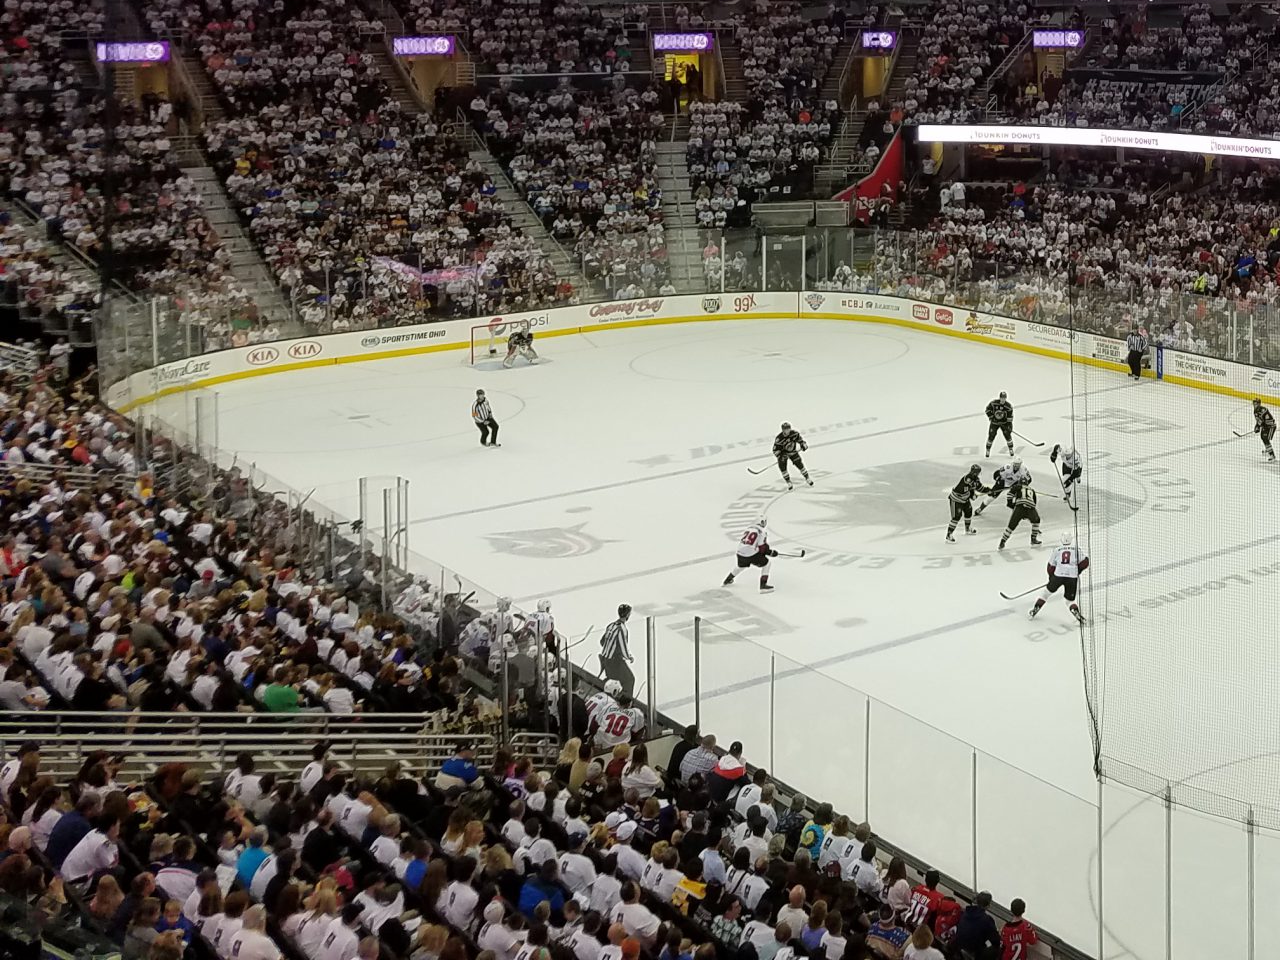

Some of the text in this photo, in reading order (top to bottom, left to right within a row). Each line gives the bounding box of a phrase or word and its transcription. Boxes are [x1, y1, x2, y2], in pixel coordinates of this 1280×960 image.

[637, 299, 665, 313] Bay
[734, 293, 757, 312] 99X
[841, 299, 864, 309] #CBJ
[509, 313, 549, 332] pepsi
[381, 330, 446, 344] SPORTSTIME OHIO
[251, 351, 273, 362] KIA
[293, 344, 317, 355] KIA
[158, 360, 211, 382] NovaCare
[1175, 359, 1185, 369] THE
[1202, 364, 1227, 378] NETWORK
[1020, 485, 1036, 501] 19
[741, 531, 758, 545] 29
[1060, 550, 1071, 564] 8
[1138, 572, 1252, 611] Loans
[604, 712, 629, 737] 10
